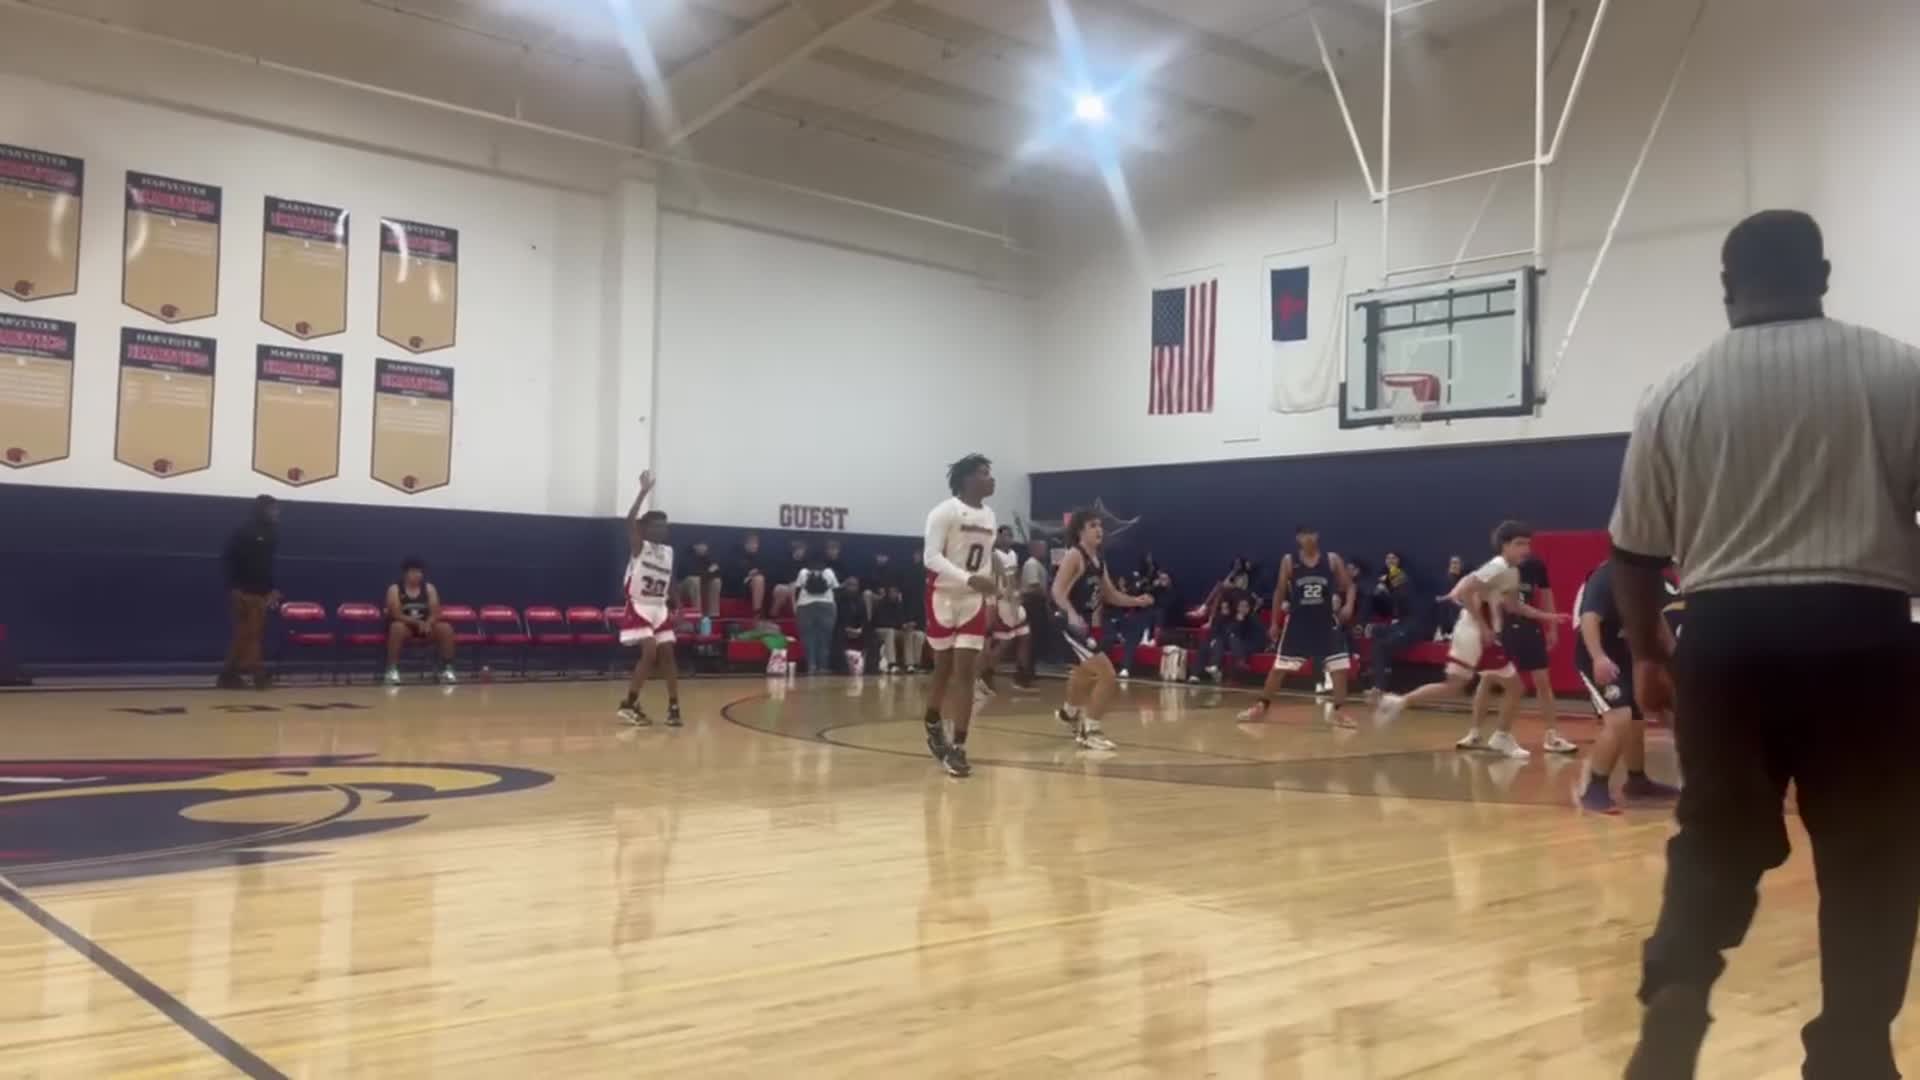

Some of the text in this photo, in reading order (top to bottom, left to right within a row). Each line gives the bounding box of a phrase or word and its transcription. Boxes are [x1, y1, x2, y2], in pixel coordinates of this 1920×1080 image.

[779, 504, 849, 530] GUEST
[966, 544, 984, 572] 0
[1303, 584, 1322, 598] 22
